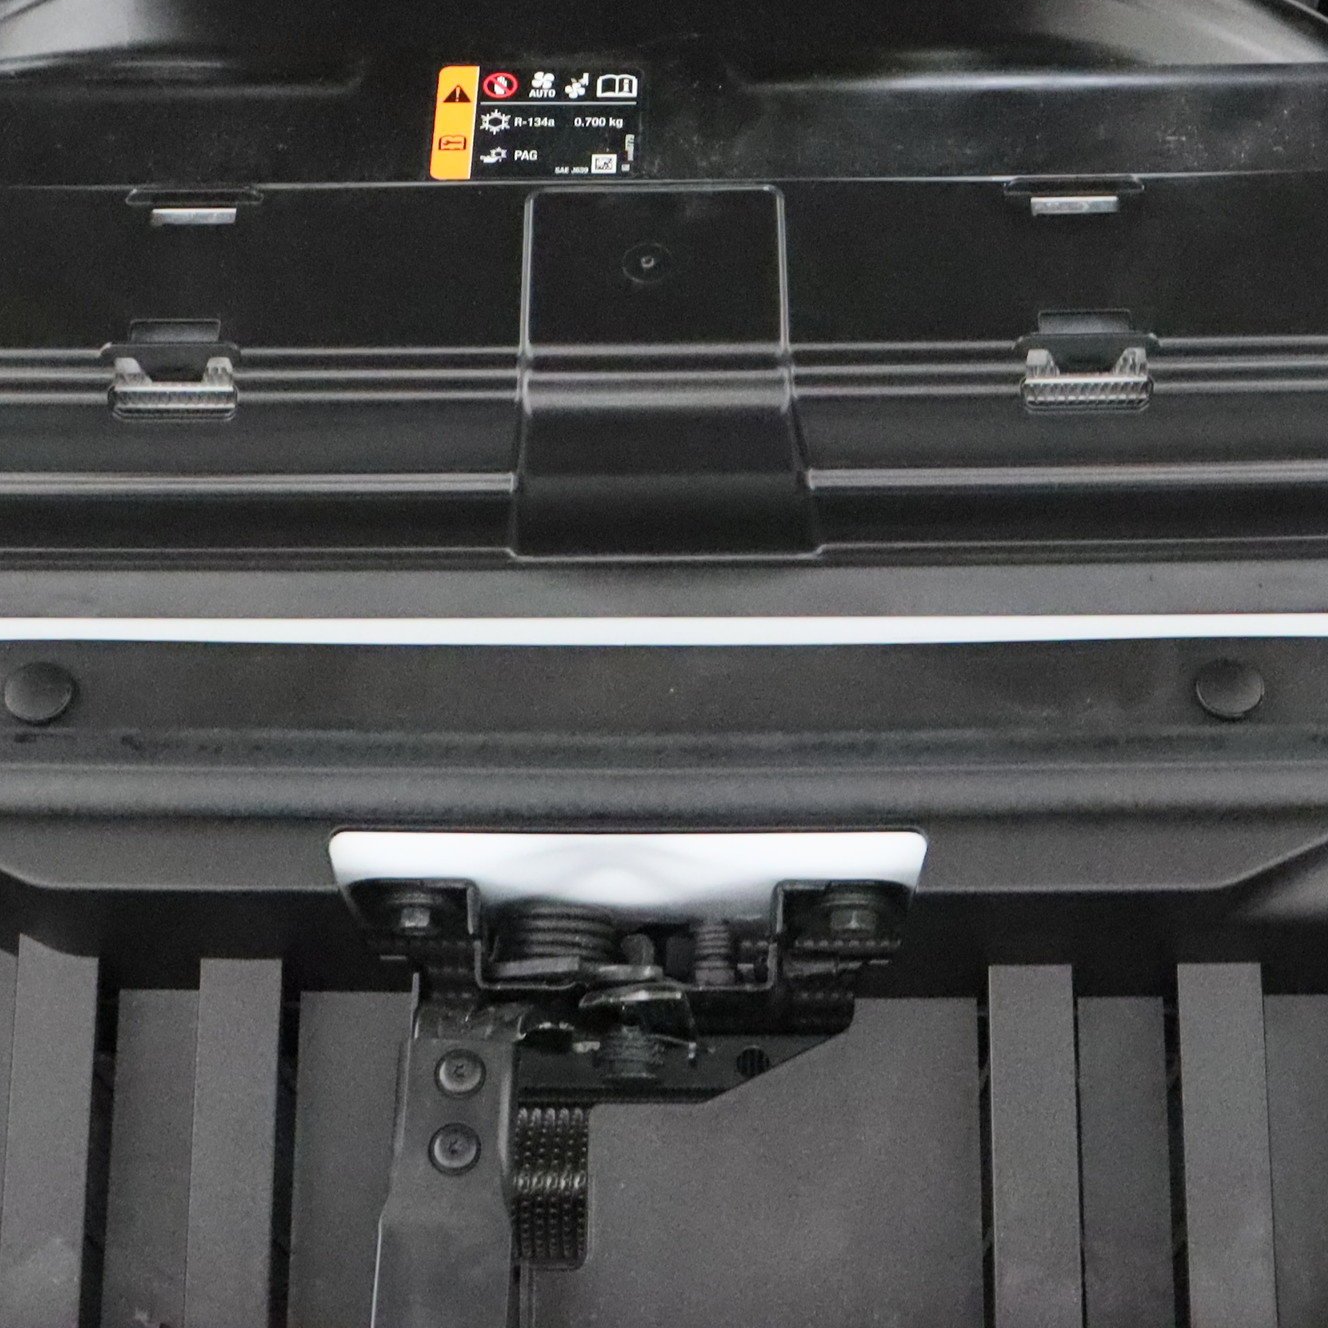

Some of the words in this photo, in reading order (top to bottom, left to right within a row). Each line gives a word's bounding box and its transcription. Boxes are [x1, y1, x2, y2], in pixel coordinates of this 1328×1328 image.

[529, 89, 556, 99] AUTO
[514, 117, 555, 128] R-134a
[574, 117, 607, 128] 0.700
[609, 117, 623, 130] kg
[514, 150, 538, 161] PAG
